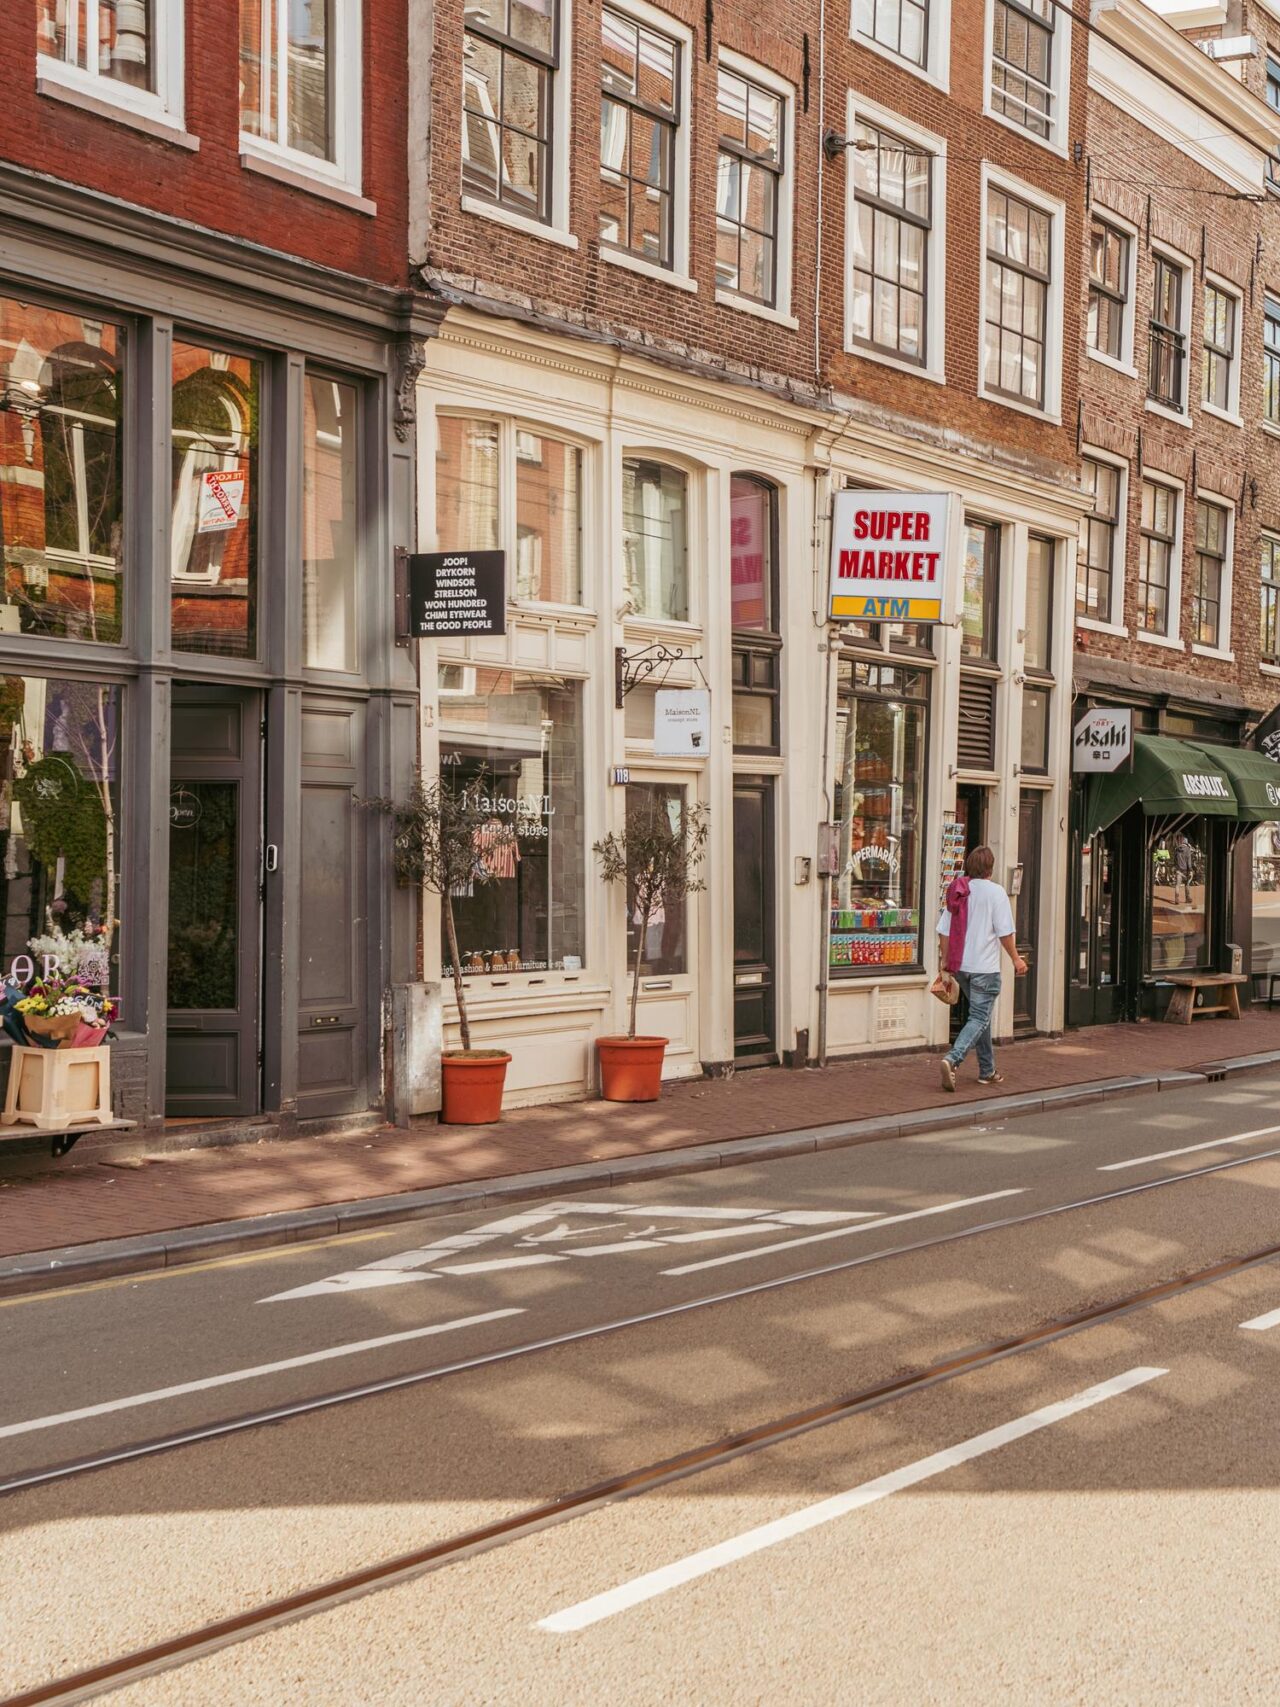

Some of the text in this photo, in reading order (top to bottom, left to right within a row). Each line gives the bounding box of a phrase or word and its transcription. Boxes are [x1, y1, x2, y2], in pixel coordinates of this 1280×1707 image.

[853, 510, 931, 542] SUPER
[443, 557, 468, 566] JOOP!
[837, 548, 941, 582] MARKET
[436, 567, 476, 577] DRYKORN
[436, 578, 476, 588] WINDSOR
[434, 588, 477, 599] STRELLSON
[424, 598, 487, 609] WON HUNDRED
[862, 598, 910, 617] ATM
[425, 609, 487, 620] CHIMI EYEWEAR
[420, 619, 492, 631] THE GOOD PEOPLE
[664, 707, 701, 716] MaisonNL
[1075, 724, 1126, 747] Asahi
[616, 768, 629, 783] 118
[518, 822, 549, 837] store
[845, 844, 901, 874] SUPERMARKET
[459, 963, 483, 974] ashion
[492, 962, 513, 972] small
